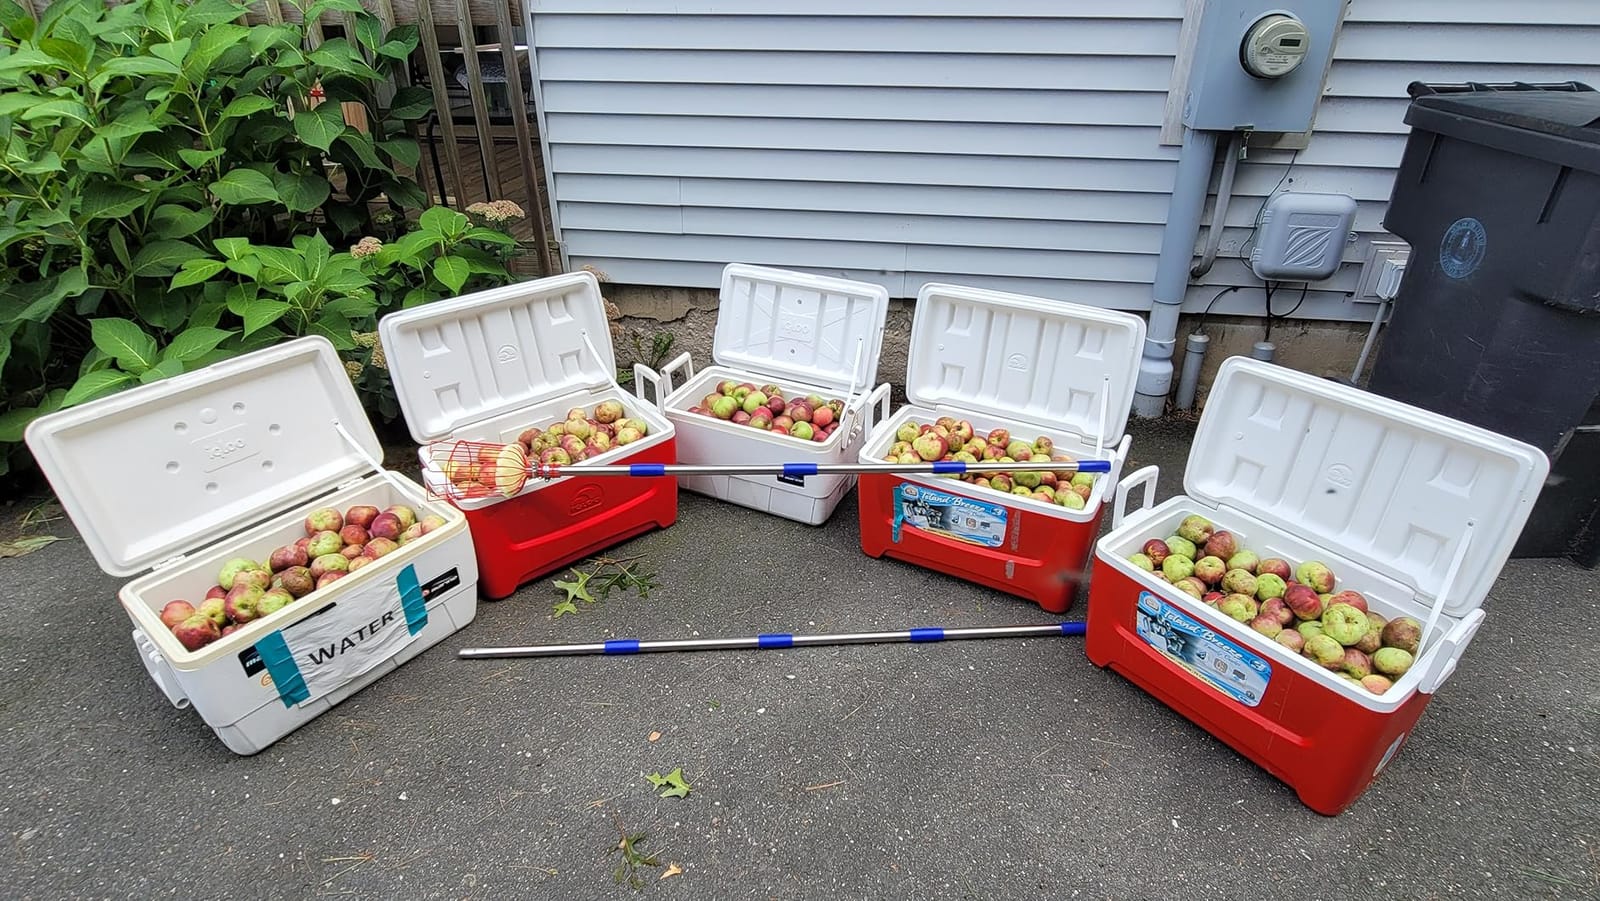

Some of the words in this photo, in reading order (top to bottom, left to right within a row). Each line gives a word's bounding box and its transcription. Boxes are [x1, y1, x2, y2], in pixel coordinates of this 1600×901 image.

[921, 491, 950, 504] Island
[951, 496, 985, 513] Breeze
[308, 610, 394, 665] WATER
[1164, 610, 1201, 634] Island
[1202, 629, 1243, 660] Breeze
